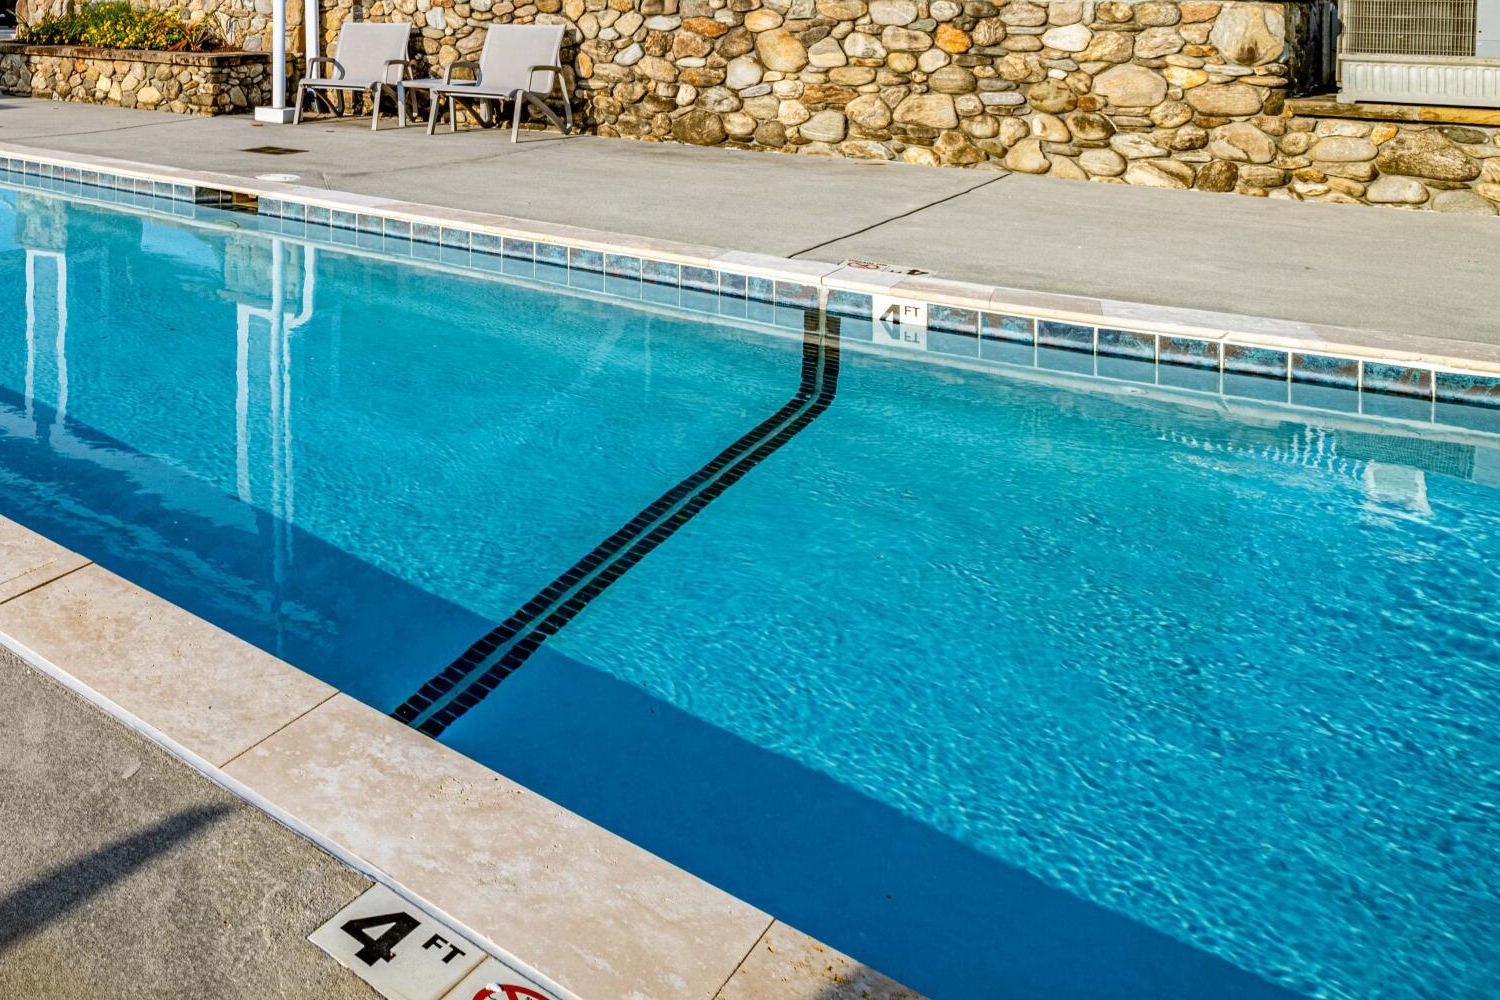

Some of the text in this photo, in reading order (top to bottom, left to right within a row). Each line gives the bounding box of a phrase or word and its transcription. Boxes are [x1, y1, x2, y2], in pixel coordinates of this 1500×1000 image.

[879, 303, 921, 325] 4 FT
[340, 911, 467, 967] 4 FT
